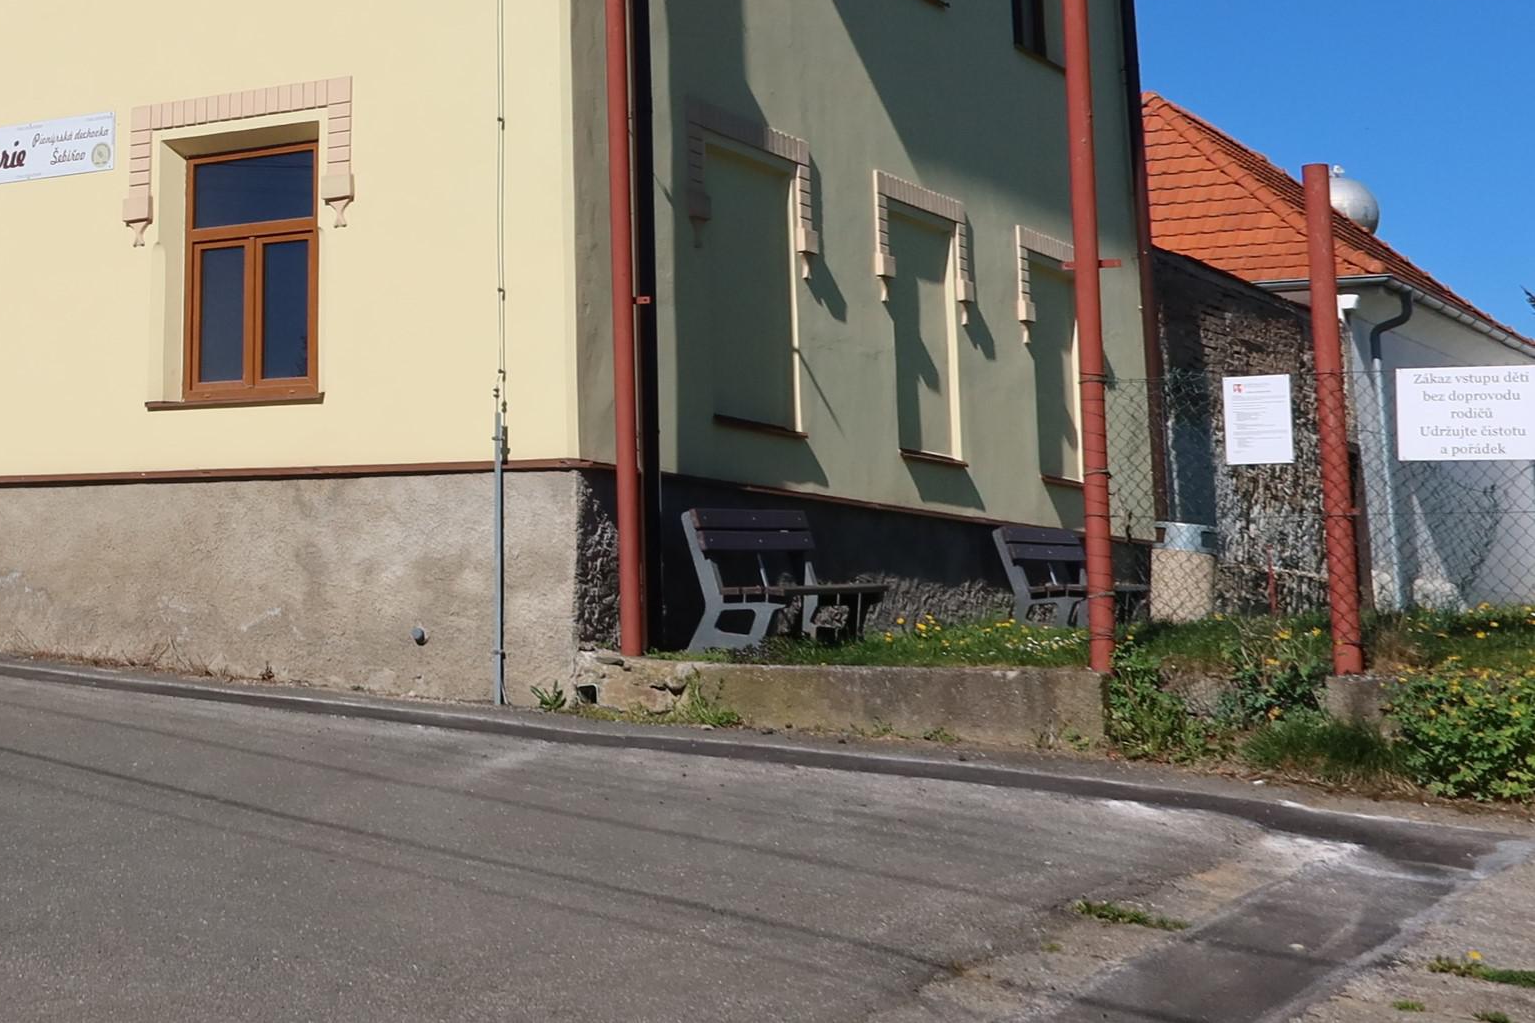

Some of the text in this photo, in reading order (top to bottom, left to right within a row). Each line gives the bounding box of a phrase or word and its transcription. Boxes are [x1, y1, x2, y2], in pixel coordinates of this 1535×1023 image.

[1413, 371, 1530, 386] Zákaz vstupu dětí
[1422, 389, 1521, 404] bez doprovodu
[1450, 407, 1493, 419] rodičů
[1419, 425, 1527, 440] Udržujte čistotu
[1440, 443, 1506, 457] a pořádek
